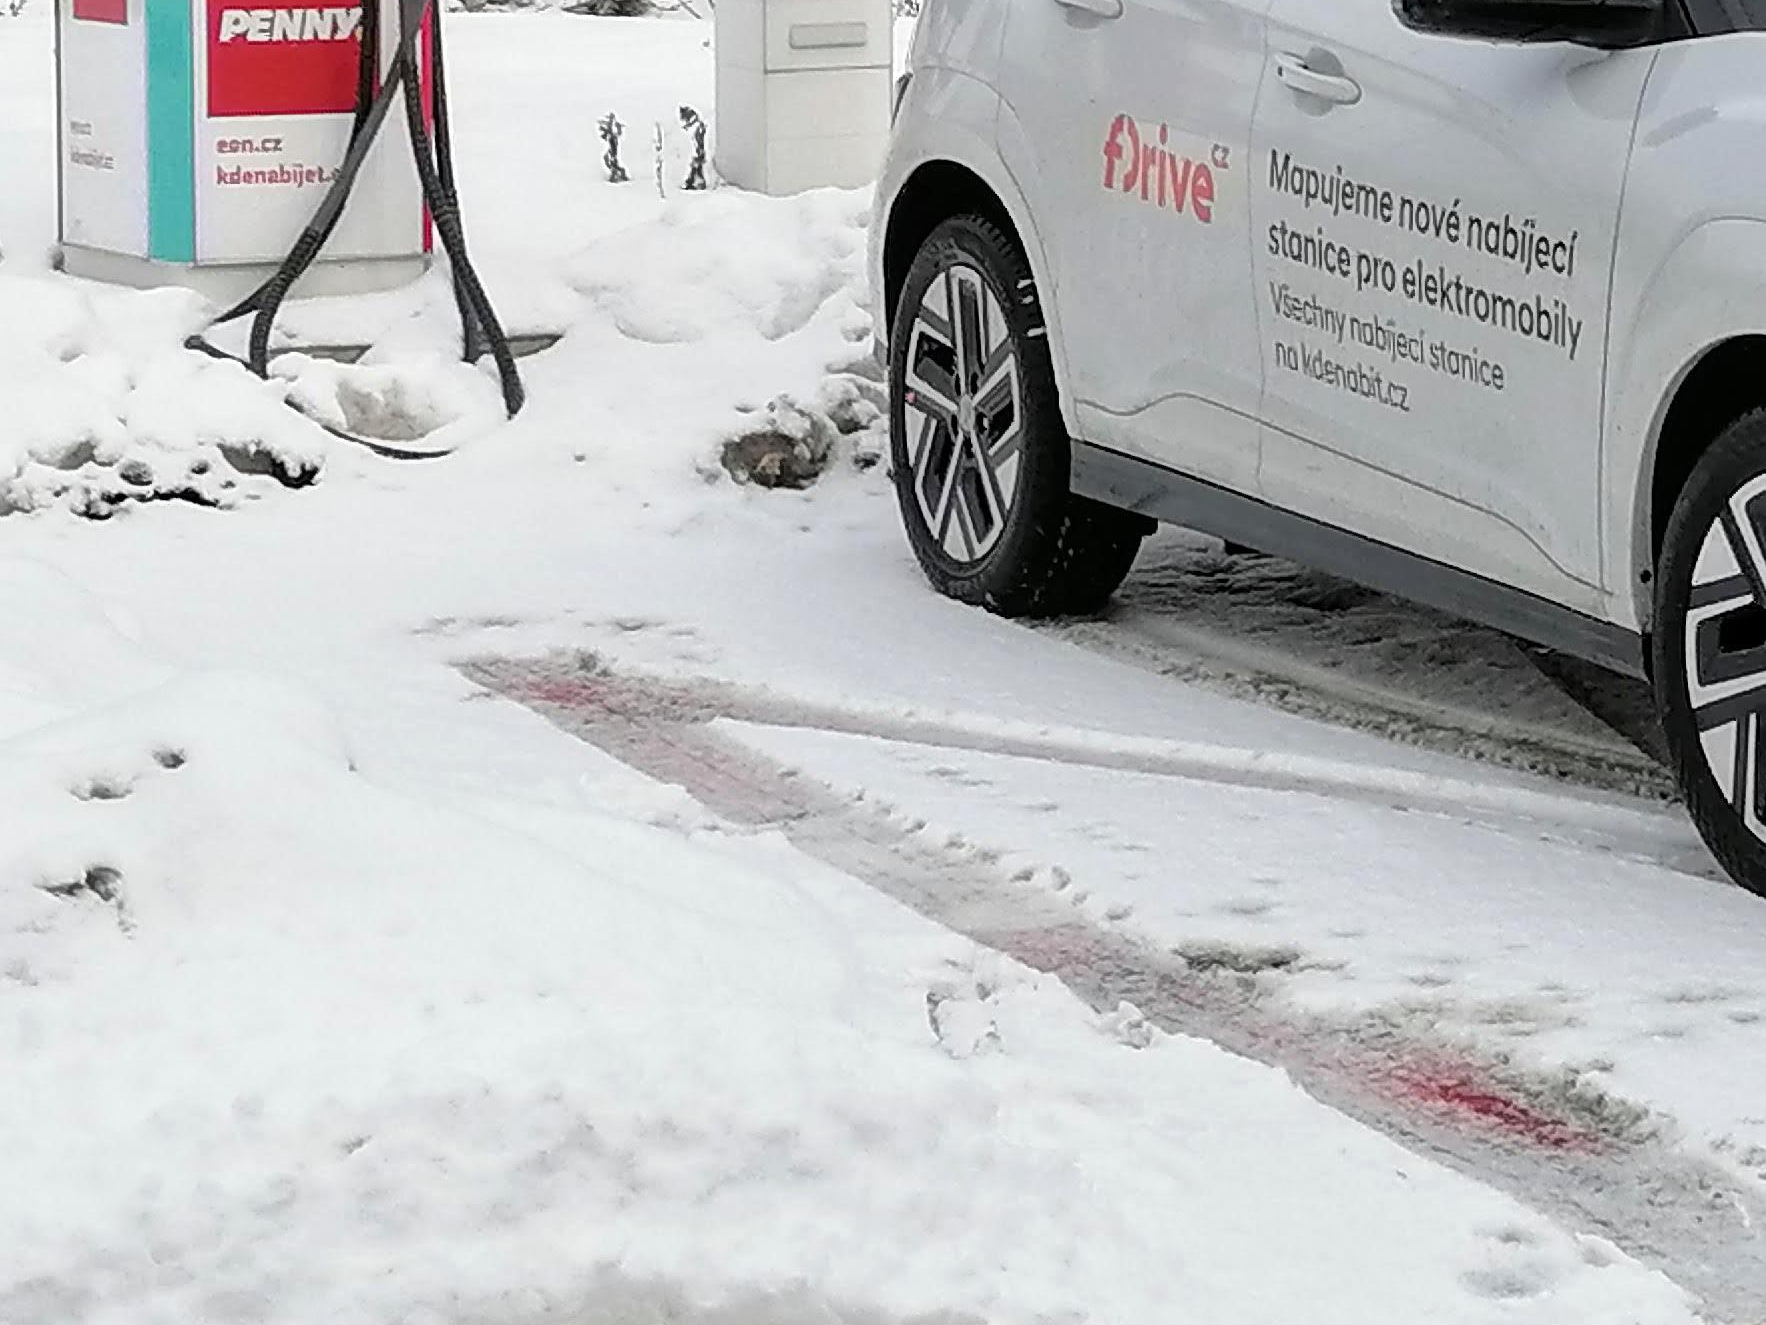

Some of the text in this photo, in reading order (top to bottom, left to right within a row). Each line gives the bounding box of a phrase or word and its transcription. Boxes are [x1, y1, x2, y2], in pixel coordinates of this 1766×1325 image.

[215, 136, 283, 154] eon.cz
[1269, 148, 1579, 276] Mapujeme nové nabíjecí
[1268, 219, 1583, 361] stanice pro elektromobily
[1269, 280, 1506, 391] Všechny nabíjecí stanice
[1275, 338, 1411, 413] na kdenabit.cz
